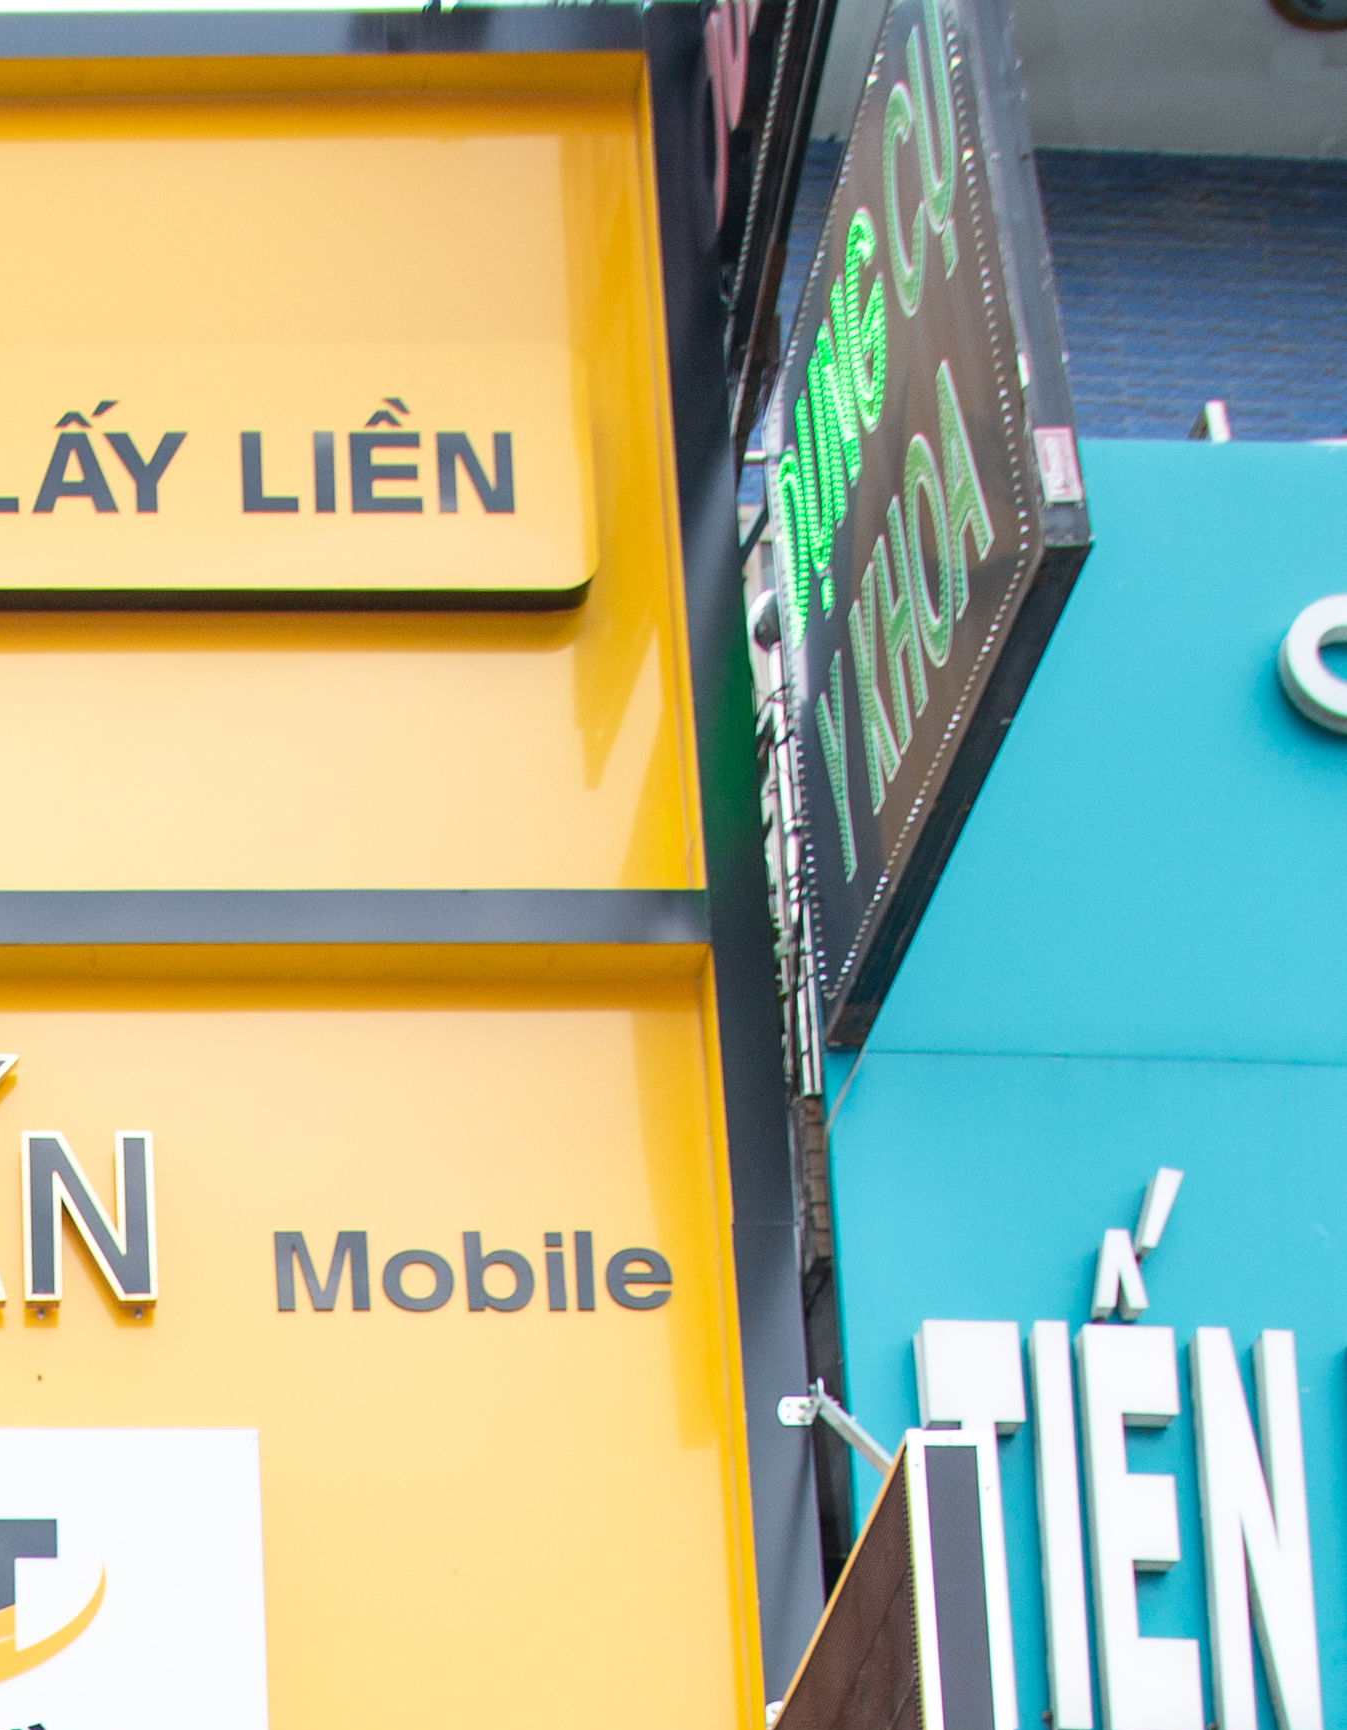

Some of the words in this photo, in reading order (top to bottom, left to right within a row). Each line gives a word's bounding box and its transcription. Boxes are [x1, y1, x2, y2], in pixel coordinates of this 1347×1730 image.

[241, 398, 515, 513] LIỀN
[776, 207, 887, 648] DỤNG
[815, 650, 858, 884] Y
[848, 359, 996, 816] KHOA
[274, 1230, 673, 1312] Mobile
